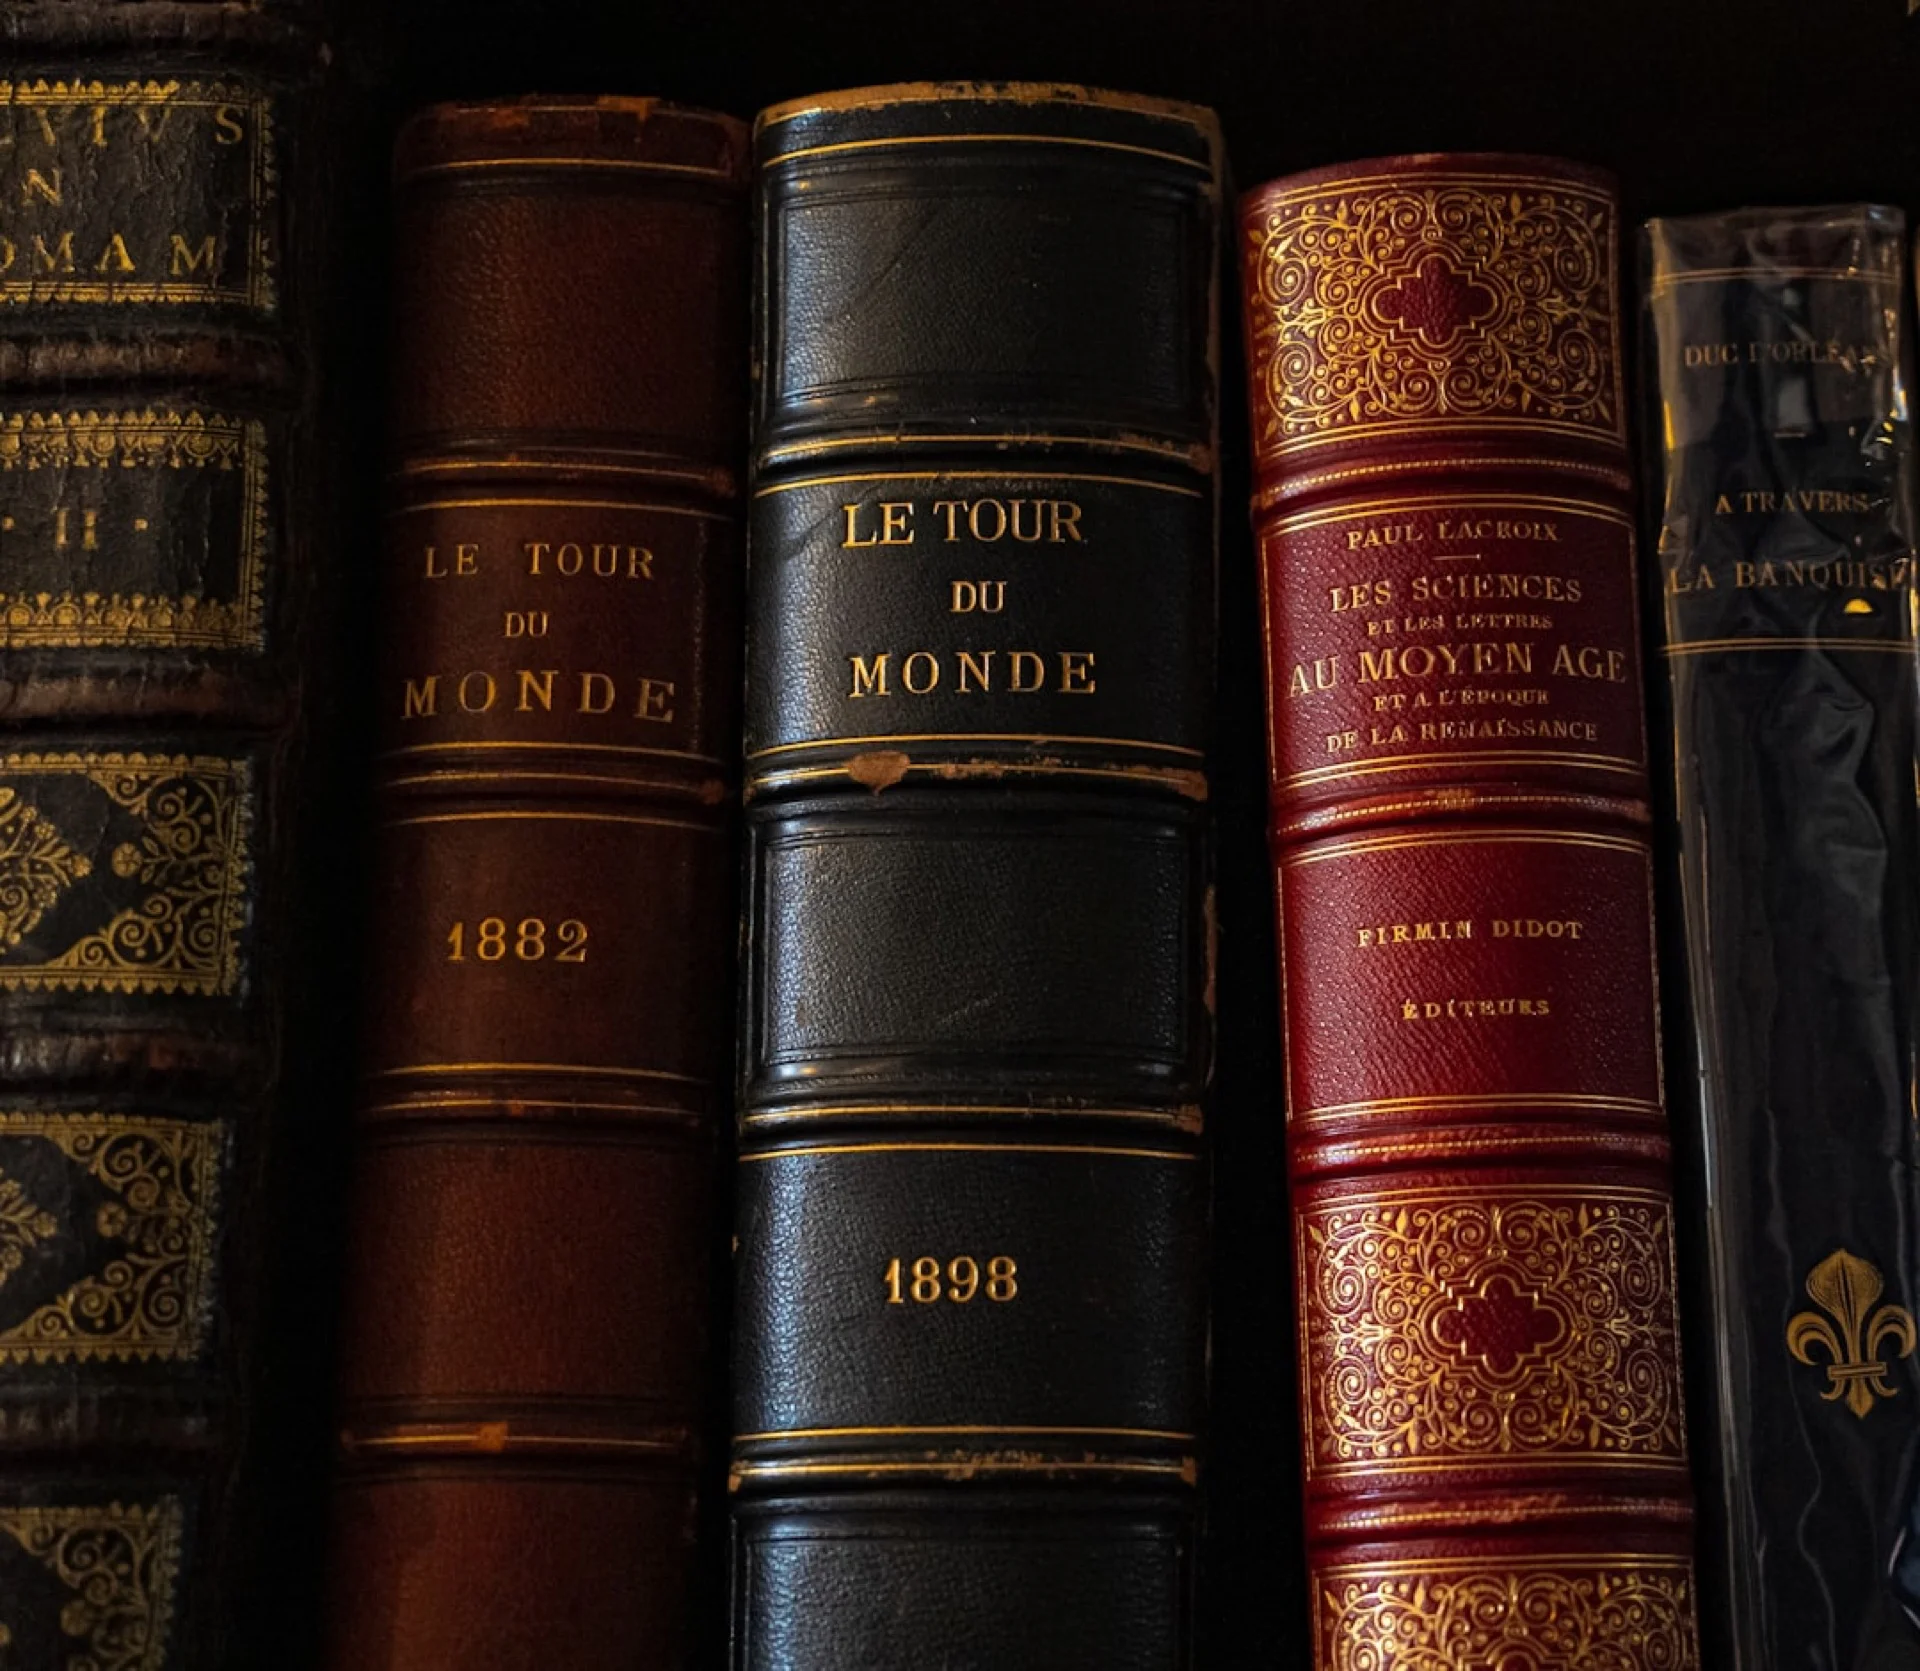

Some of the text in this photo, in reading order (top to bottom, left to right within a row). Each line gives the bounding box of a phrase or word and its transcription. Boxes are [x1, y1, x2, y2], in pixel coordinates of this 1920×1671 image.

[1684, 342, 1739, 367] DUC
[1715, 490, 1870, 514] A TRAVERS
[841, 498, 1087, 549] LE TOUR
[1346, 519, 1563, 551] PAUL LACROIX
[423, 541, 654, 580] LE TOUR
[1329, 573, 1584, 613] LES SCIENCES
[1670, 564, 1716, 593] LA
[949, 580, 1009, 613] DU
[503, 610, 550, 638] DU
[1367, 611, 1554, 637] ET LES LETTRES
[848, 650, 1097, 698] MONDE
[1288, 641, 1627, 698] AU MOYEN AGE
[400, 668, 676, 724] MONDE
[1372, 693, 1407, 712] ET
[1326, 717, 1598, 753] DE LA RENAISSANCE
[446, 916, 589, 963] 1882
[1356, 919, 1584, 948] FIRMIN DIDOT
[883, 1255, 1019, 1304] 1898
